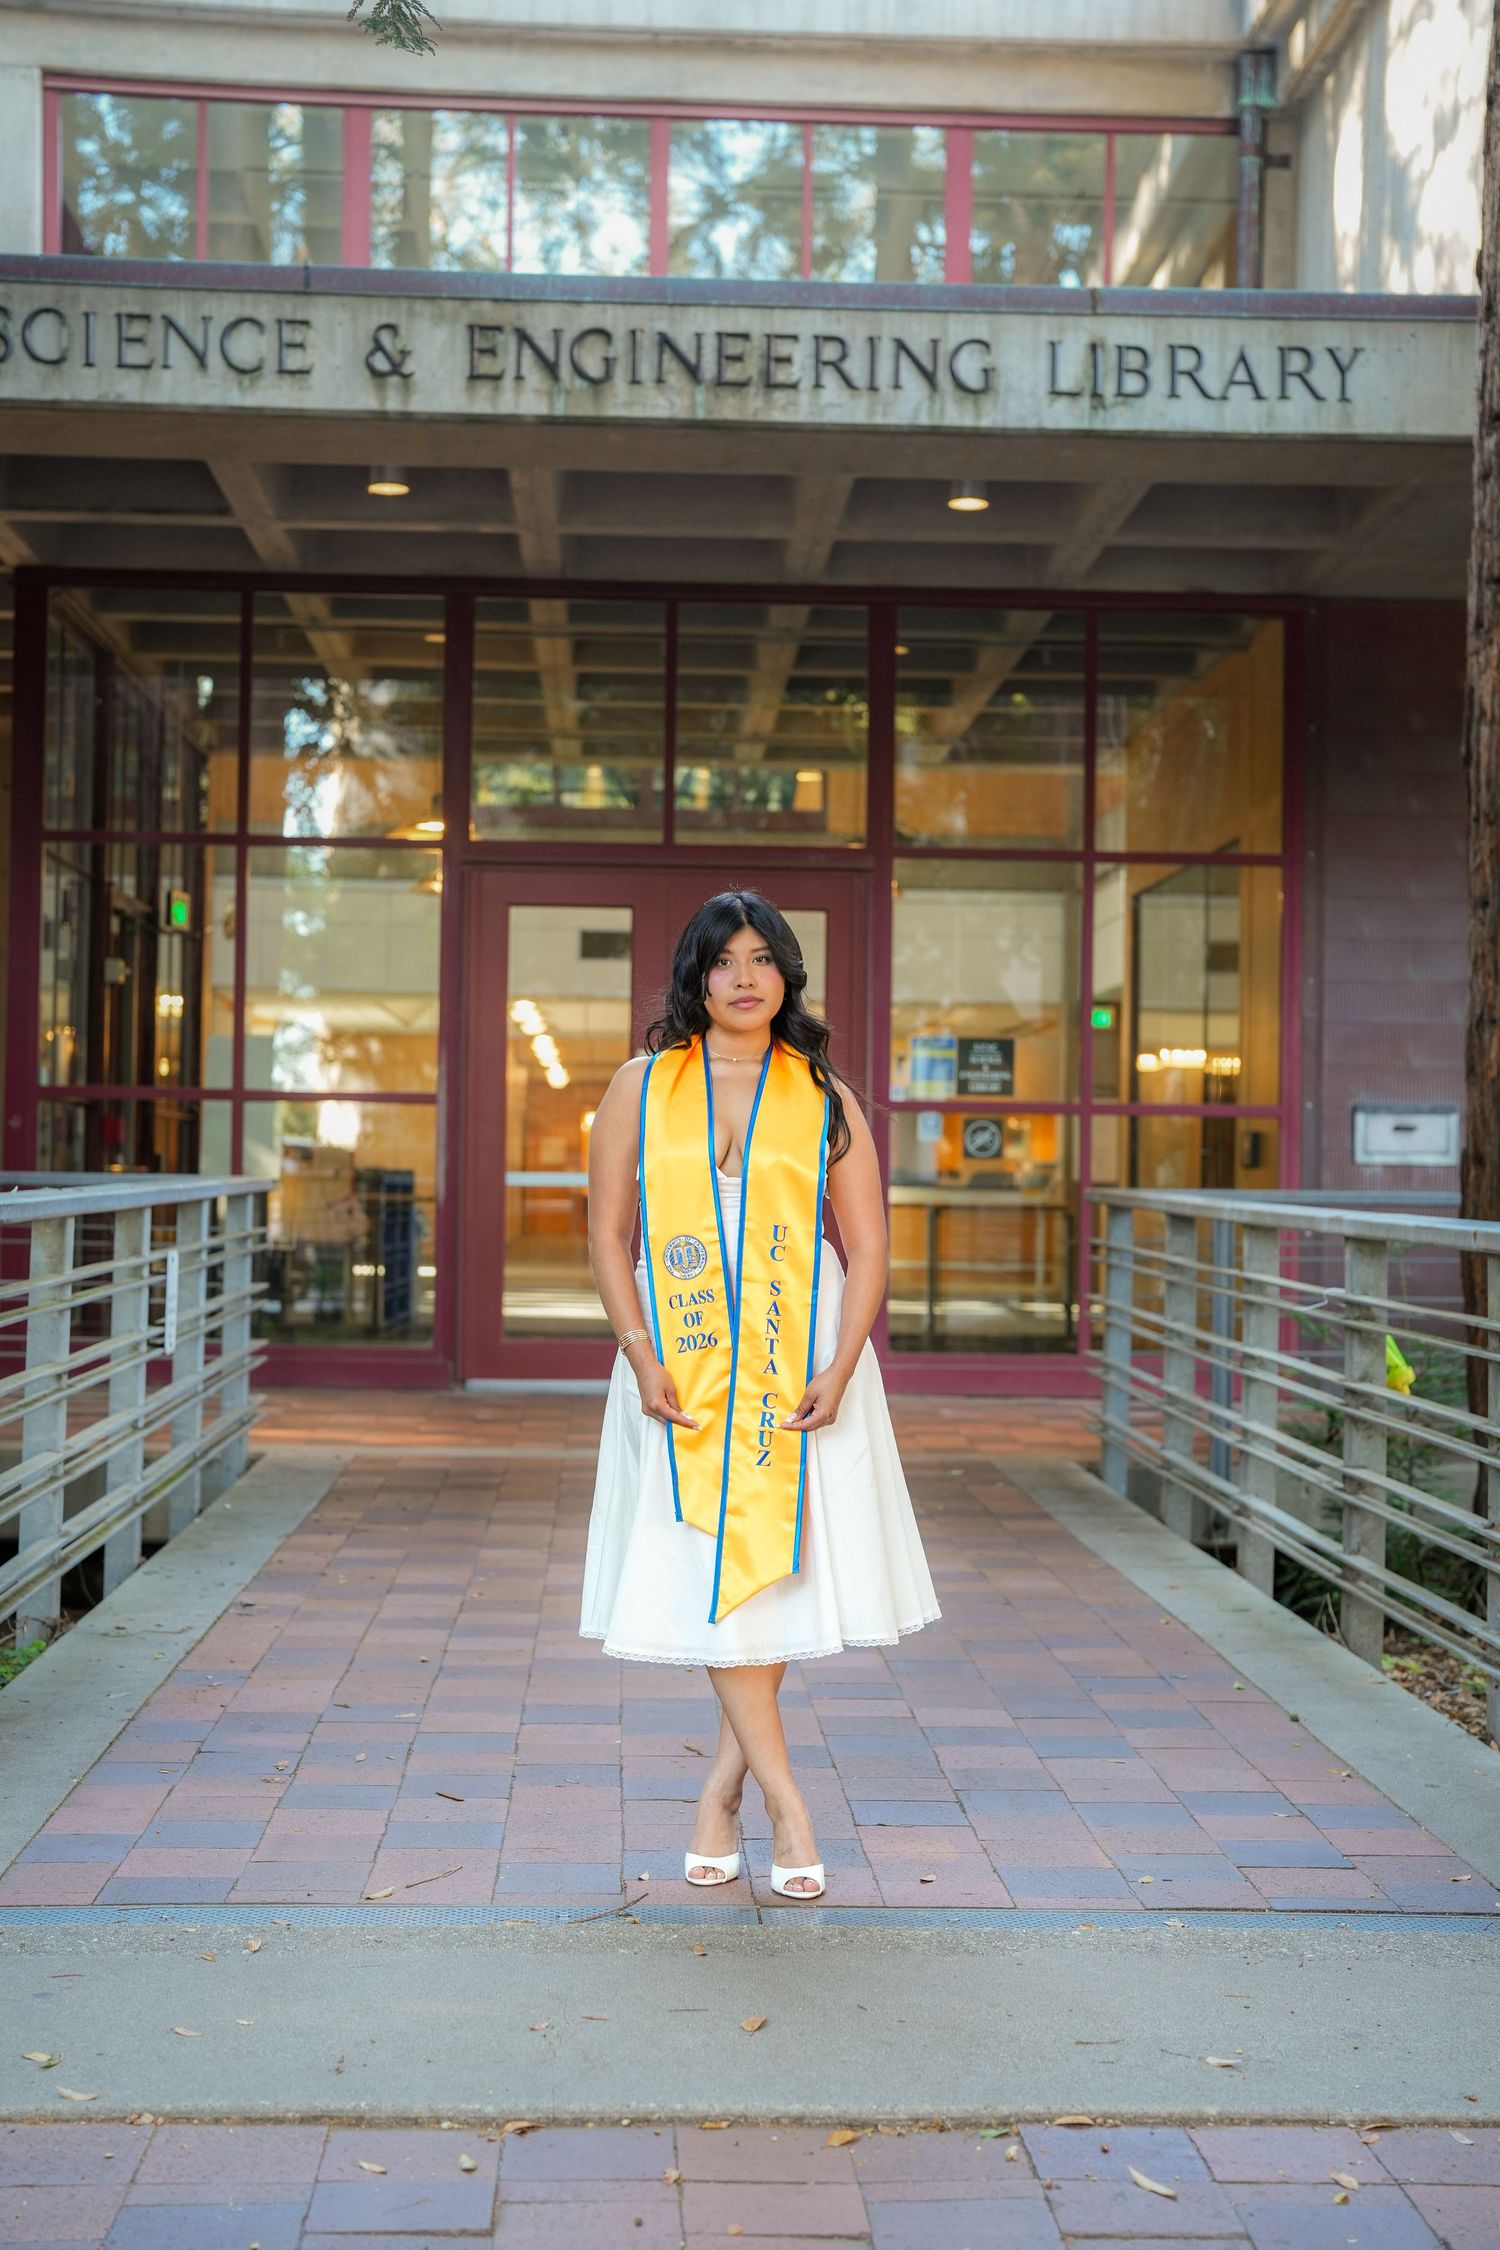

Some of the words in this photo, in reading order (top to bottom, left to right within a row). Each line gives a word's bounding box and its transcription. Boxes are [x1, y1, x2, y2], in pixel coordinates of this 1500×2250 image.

[365, 322, 415, 379] &
[466, 324, 996, 396] ENGINEERING
[1047, 339, 1365, 402] LIBRARY
[769, 1224, 788, 1263] UC
[668, 1288, 715, 1310] CLASS
[683, 1310, 704, 1328] OF
[762, 1279, 782, 1376] SANTA
[675, 1330, 718, 1354] 2026
[755, 1392, 778, 1468] CRUZ
